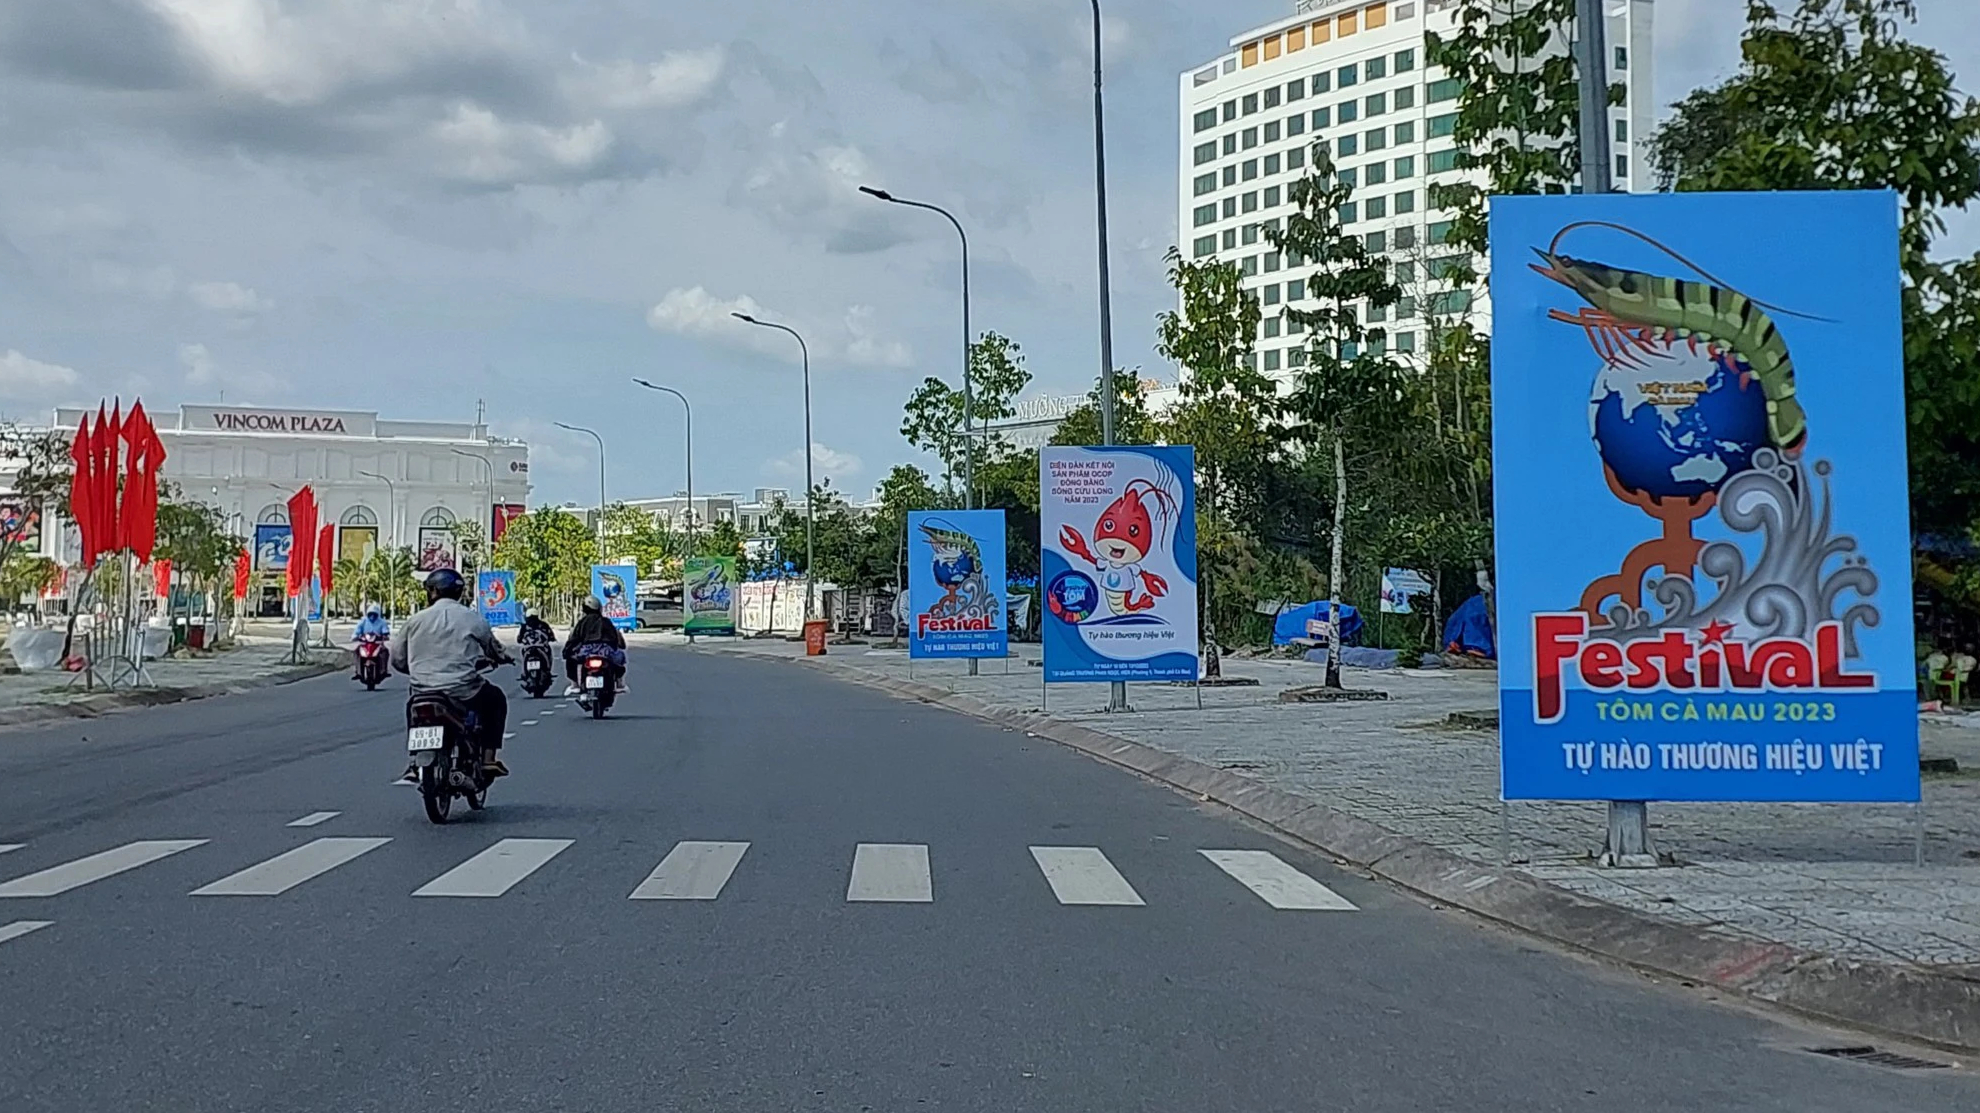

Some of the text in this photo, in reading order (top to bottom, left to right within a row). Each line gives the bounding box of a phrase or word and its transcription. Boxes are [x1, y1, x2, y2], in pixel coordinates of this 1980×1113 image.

[214, 413, 346, 432] VINCOM PLAZA
[1091, 470, 1113, 478] OCOP
[1092, 487, 1114, 495] LONG
[1596, 697, 1837, 721] TÔM CÀ MAU 2023
[1562, 738, 1884, 776] TỰ HÀO THƯƠNG HIỆU VIỆT
